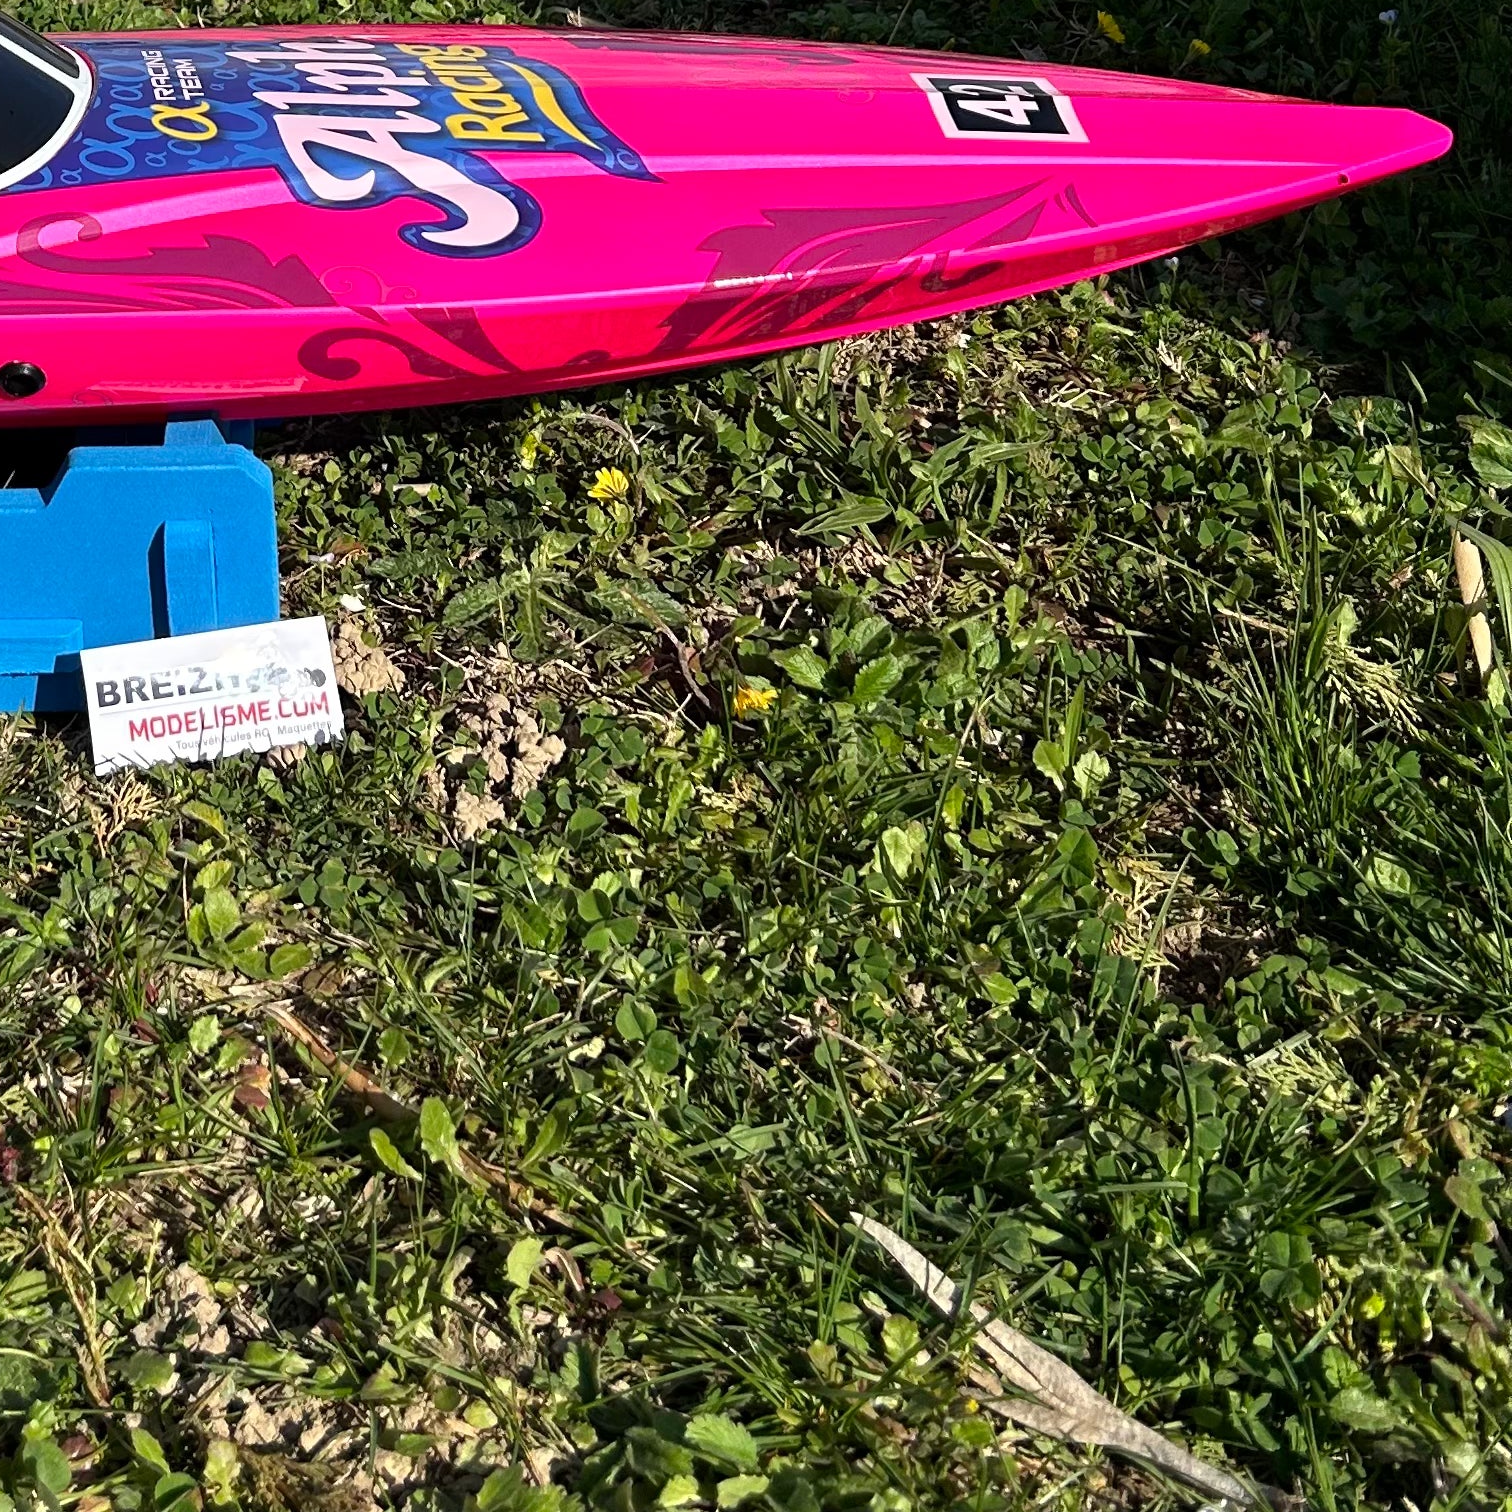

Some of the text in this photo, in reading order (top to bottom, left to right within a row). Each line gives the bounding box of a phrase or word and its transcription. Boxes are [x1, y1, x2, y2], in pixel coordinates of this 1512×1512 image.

[141, 50, 177, 101] RACING
[172, 59, 205, 101] TEAM
[394, 43, 545, 143] Racing
[949, 84, 1040, 126] 42
[226, 39, 519, 247] Alph
[129, 691, 329, 741] MODELISME.COM
[202, 732, 252, 747] véhcules
